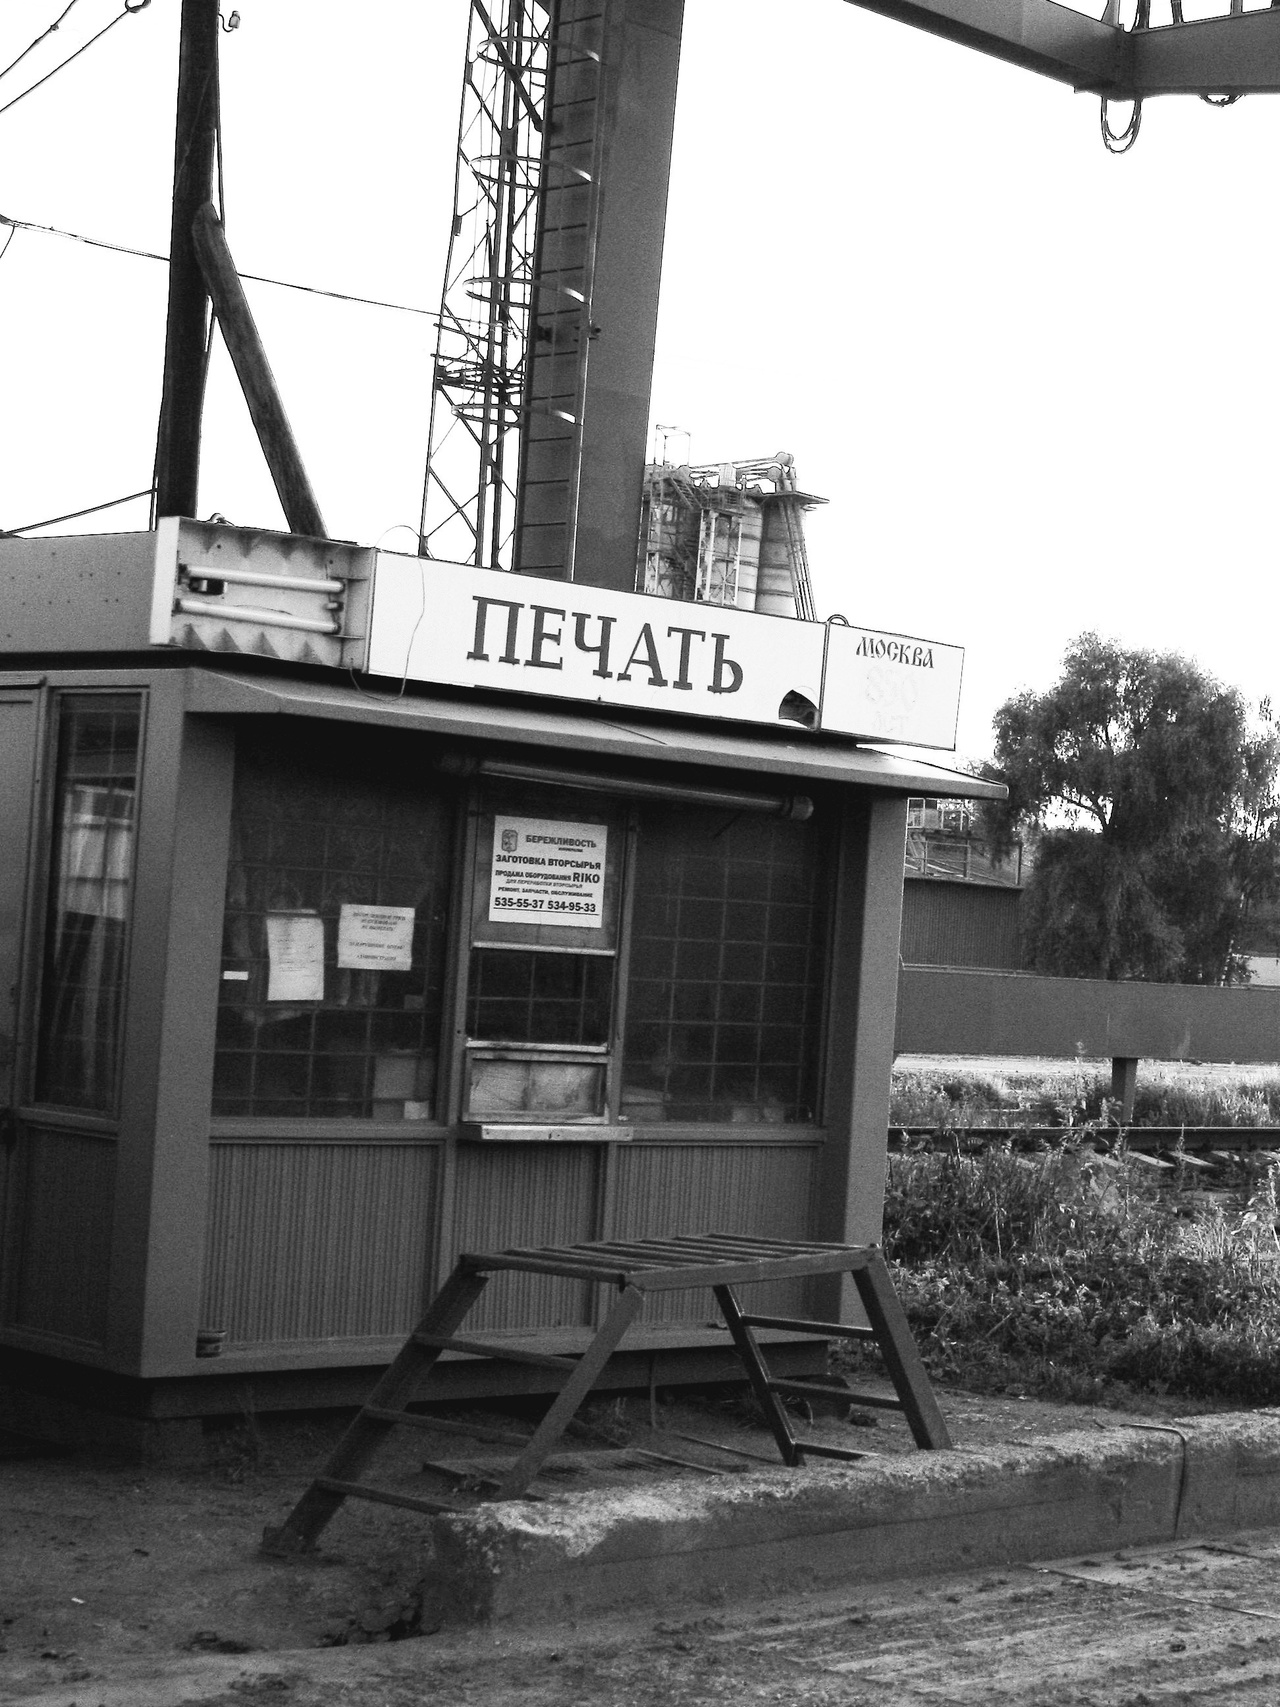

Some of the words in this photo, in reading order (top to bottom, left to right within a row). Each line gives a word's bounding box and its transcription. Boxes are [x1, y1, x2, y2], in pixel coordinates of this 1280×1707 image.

[466, 595, 744, 694] ПЕЧАТЬ
[855, 636, 935, 669] МОСКВА
[526, 834, 597, 848] БЕРЕЖЛИВОСТЬ
[495, 854, 546, 866] ЗАГОТОВКА
[548, 858, 601, 870] ВТОРСЫРЬЯ
[495, 869, 524, 878] ПРОДАЖА
[572, 872, 600, 884] RIKO
[494, 896, 545, 909] 535-55-37
[547, 900, 596, 912] 534-95-33
